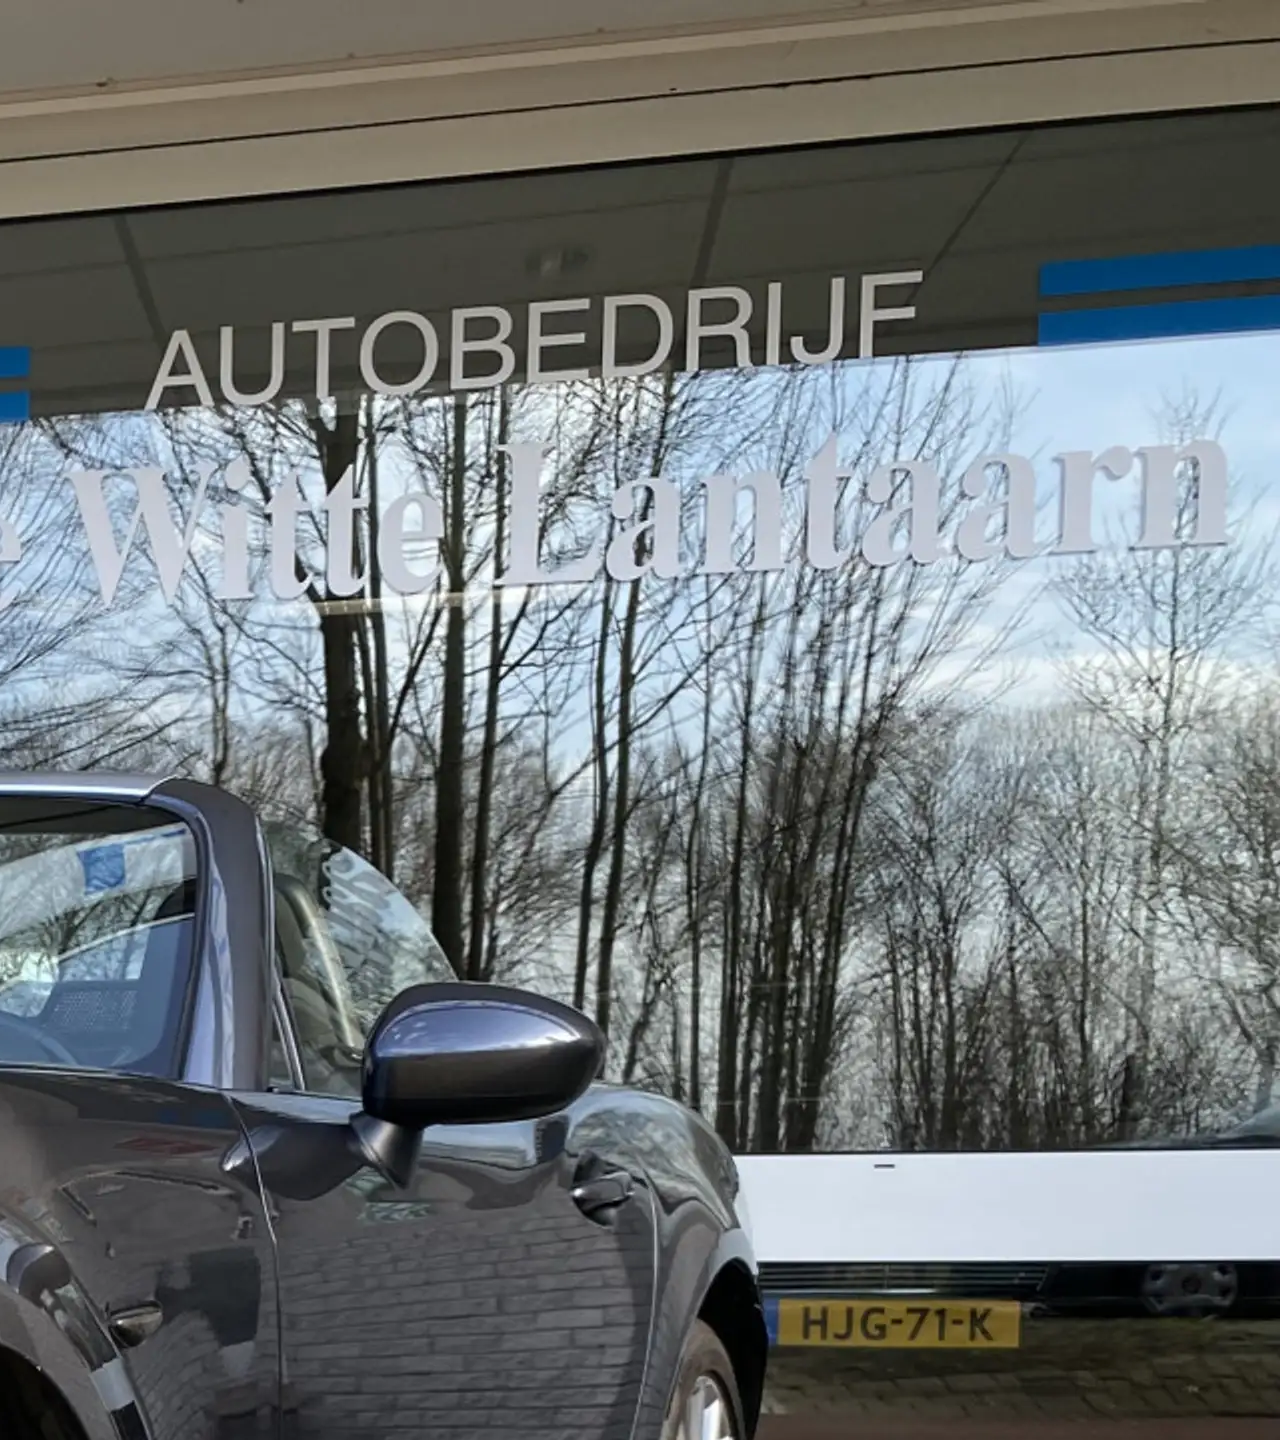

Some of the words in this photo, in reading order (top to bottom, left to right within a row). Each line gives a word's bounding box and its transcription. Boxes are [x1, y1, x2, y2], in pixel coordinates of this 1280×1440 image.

[145, 270, 925, 411] AUTOBEDRIJF
[68, 455, 447, 609] Witte
[493, 433, 1230, 588] Lantaarn
[802, 1307, 993, 1341] HJG-71-K
